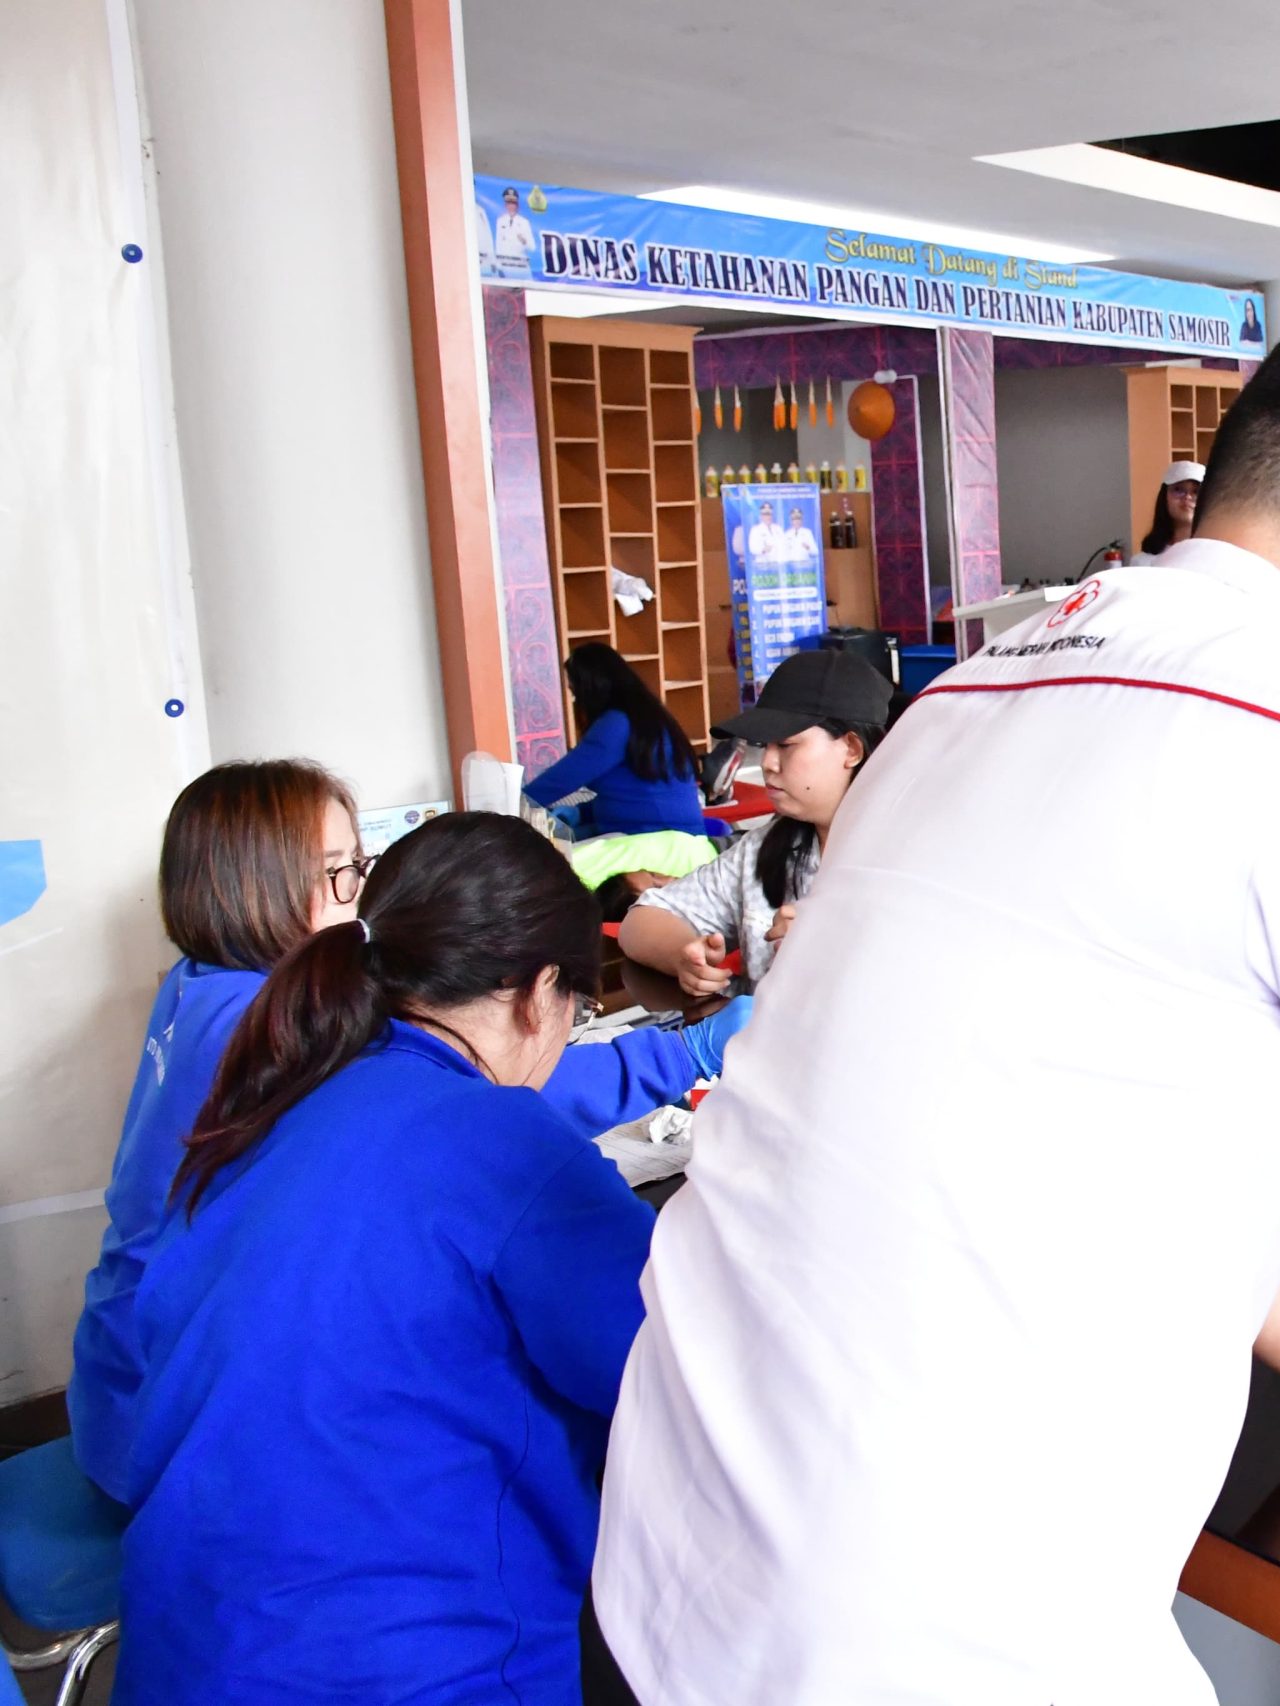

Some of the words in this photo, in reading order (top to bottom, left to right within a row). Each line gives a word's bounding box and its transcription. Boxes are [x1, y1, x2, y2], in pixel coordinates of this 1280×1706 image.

[541, 232, 638, 282] DINAS
[648, 245, 808, 300] KETAHANAN
[817, 266, 907, 310] PANGAN
[916, 279, 956, 314] DAN
[964, 287, 1067, 327] PERTANIAN
[1073, 300, 1164, 338] KABUPATEN
[1169, 315, 1231, 347] SAMOSIR
[825, 228, 917, 265] Selamat
[921, 242, 999, 288] Datang
[1002, 256, 1020, 280] di
[1024, 259, 1079, 290] Stand
